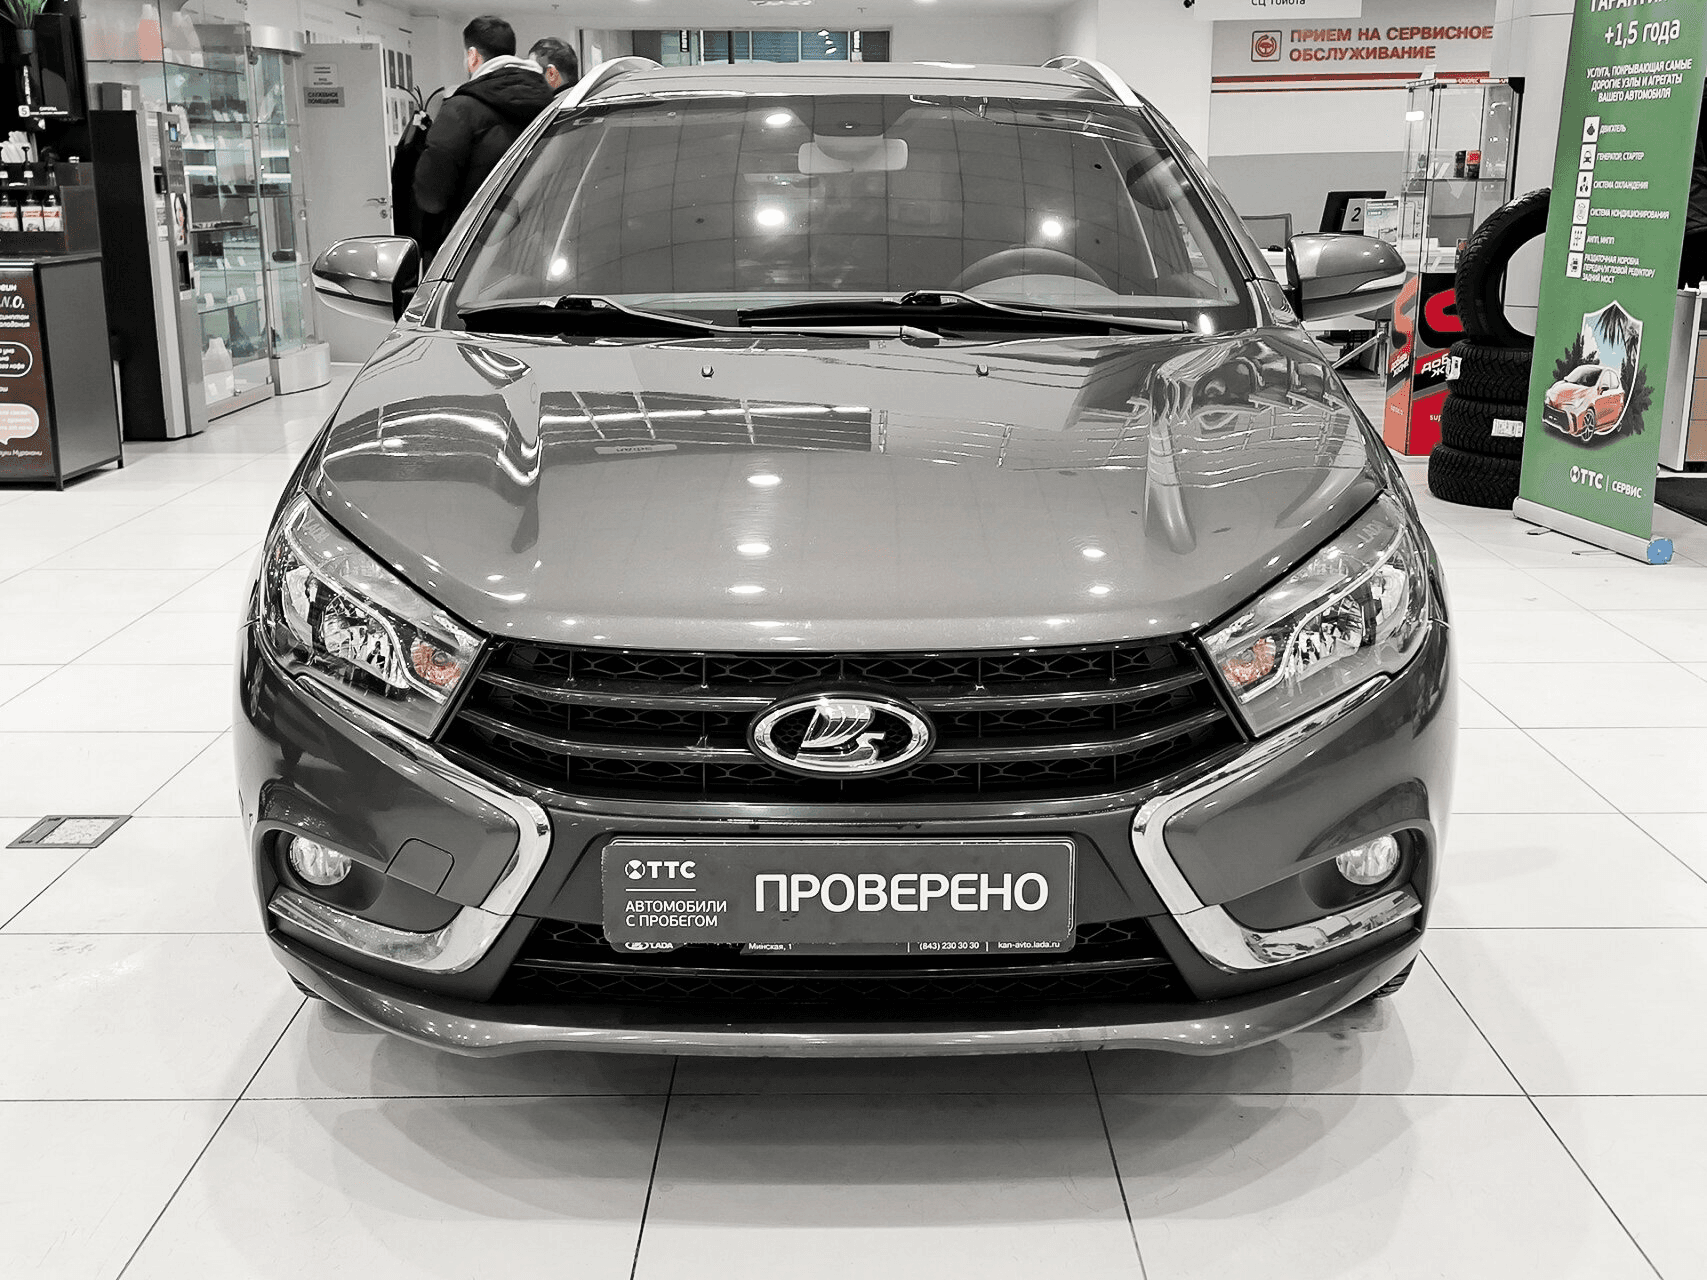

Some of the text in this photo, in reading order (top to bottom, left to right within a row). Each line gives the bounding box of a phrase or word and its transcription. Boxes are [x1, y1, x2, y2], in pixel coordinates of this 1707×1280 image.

[1290, 25, 1494, 43] ПРИЕМ НА СЕРВИСНОЕ
[1604, 19, 1681, 49] +1,5 года
[1289, 45, 1437, 62] ОБСЛУЖИВАНИЕ
[1586, 58, 1693, 79] УСЛУГА, ПОКРЫВАЮЩАЯ САМЫЕ
[1590, 78, 1622, 93] ДОРОГИЕ
[1622, 76, 1641, 89] УЗЛЫ
[1648, 73, 1683, 87] АГРЕГАТЫ
[1597, 87, 1672, 103] ВАШЕГО АВТОМОБИЛЯ
[1622, 152, 1645, 161] СТАРТЕР
[1593, 181, 1649, 190] СИСТЕМА ОХЛАЖДЕНИЯ
[1351, 206, 1362, 222] 2
[1590, 208, 1670, 219] СИСТЕМА КОНДИЦИОНИРОВАНИЯ
[1617, 256, 1640, 266] КОРОБКА
[1601, 275, 1616, 284] МОСТ
[1611, 480, 1643, 499] СЕРВИС
[646, 860, 697, 879] ТТС
[754, 872, 1049, 913] ПРОВЕРЕНО
[625, 900, 728, 913] АВТОМОБИЛИ
[625, 914, 718, 927] С ПРОБЕГОМ
[649, 941, 674, 949] LADA
[748, 942, 786, 951] Минская,
[919, 941, 980, 950] (843) 230 30 30
[998, 941, 1061, 950] kan-avto.lada.ru
